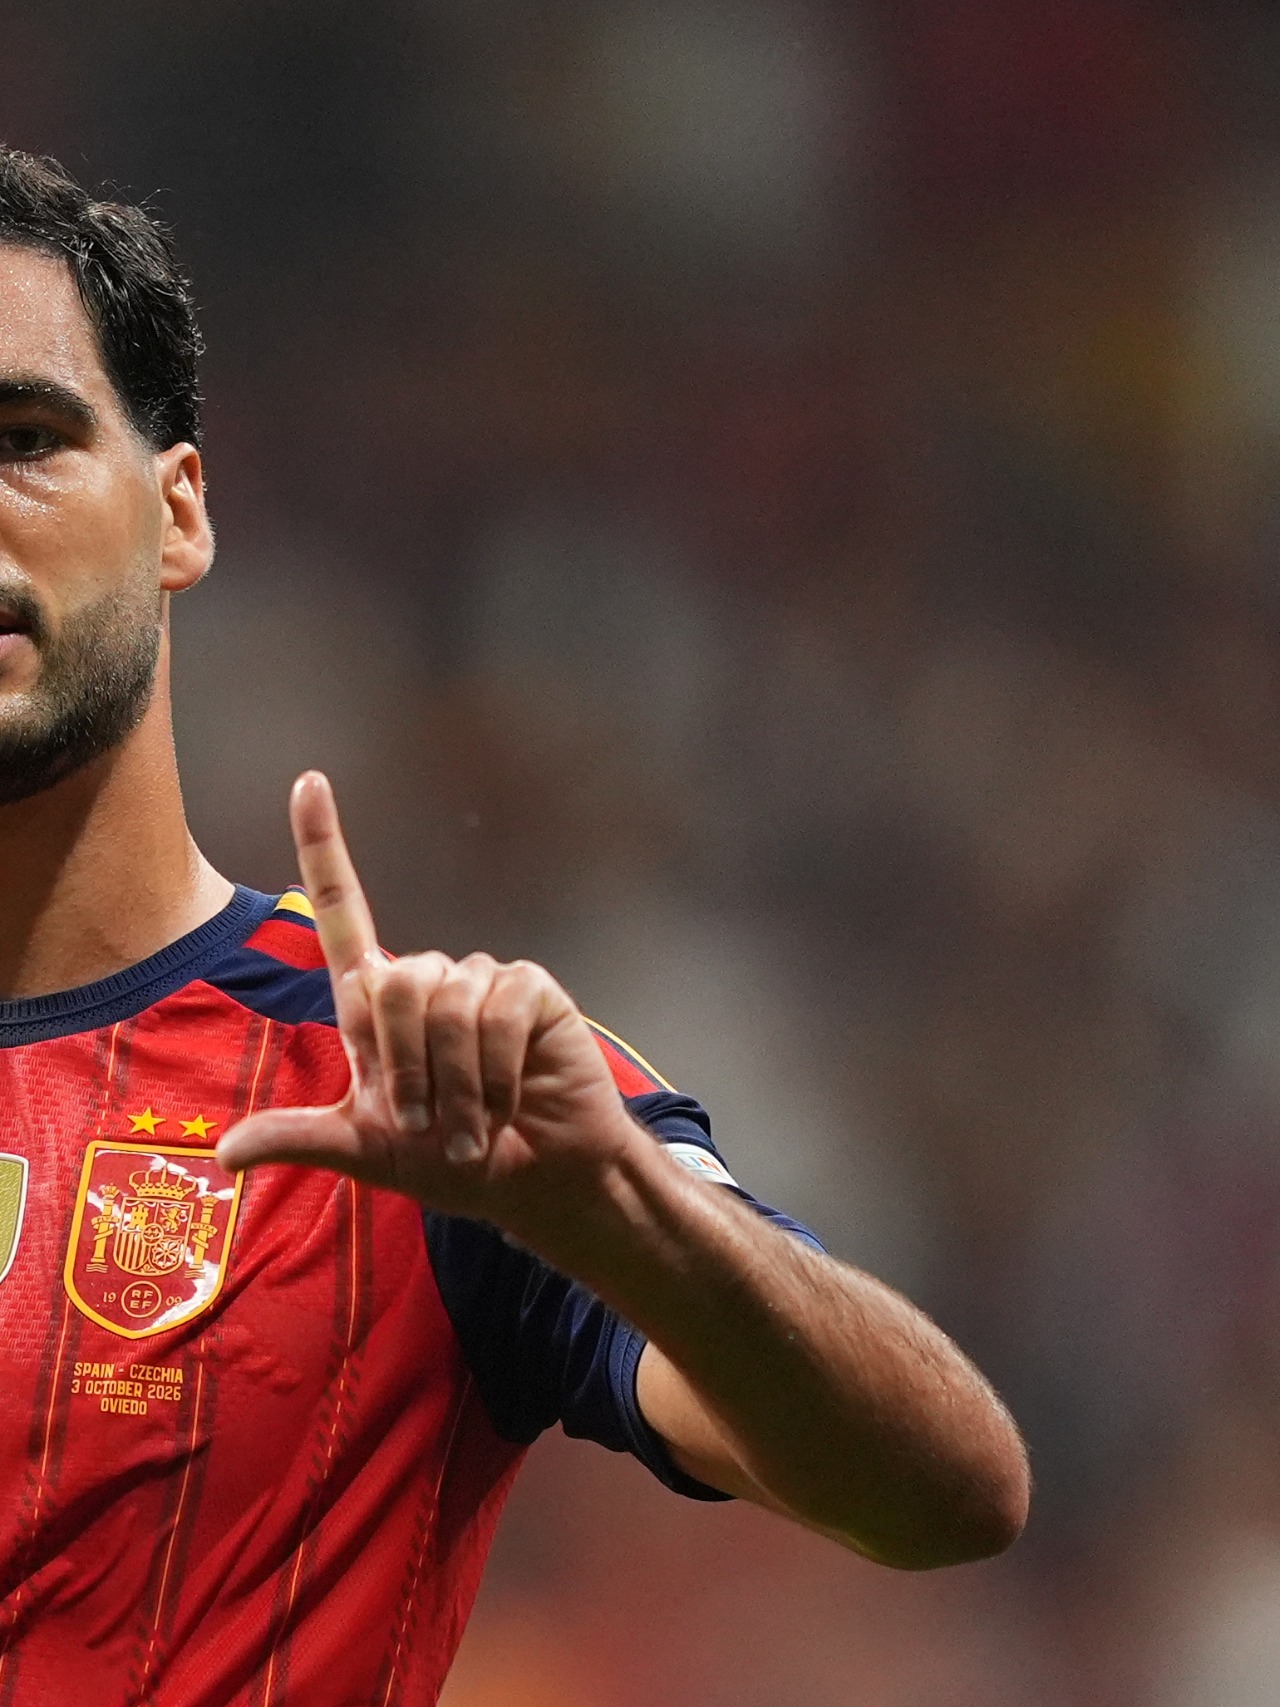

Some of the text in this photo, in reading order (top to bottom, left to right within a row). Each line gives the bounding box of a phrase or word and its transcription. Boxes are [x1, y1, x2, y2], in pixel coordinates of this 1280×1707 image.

[103, 1291, 117, 1303] 19
[73, 1362, 115, 1378] SPAIN
[129, 1364, 184, 1384] CZECHIA
[71, 1379, 182, 1401] 3 OCTOBER 2026
[100, 1397, 148, 1415] OVIEDO
